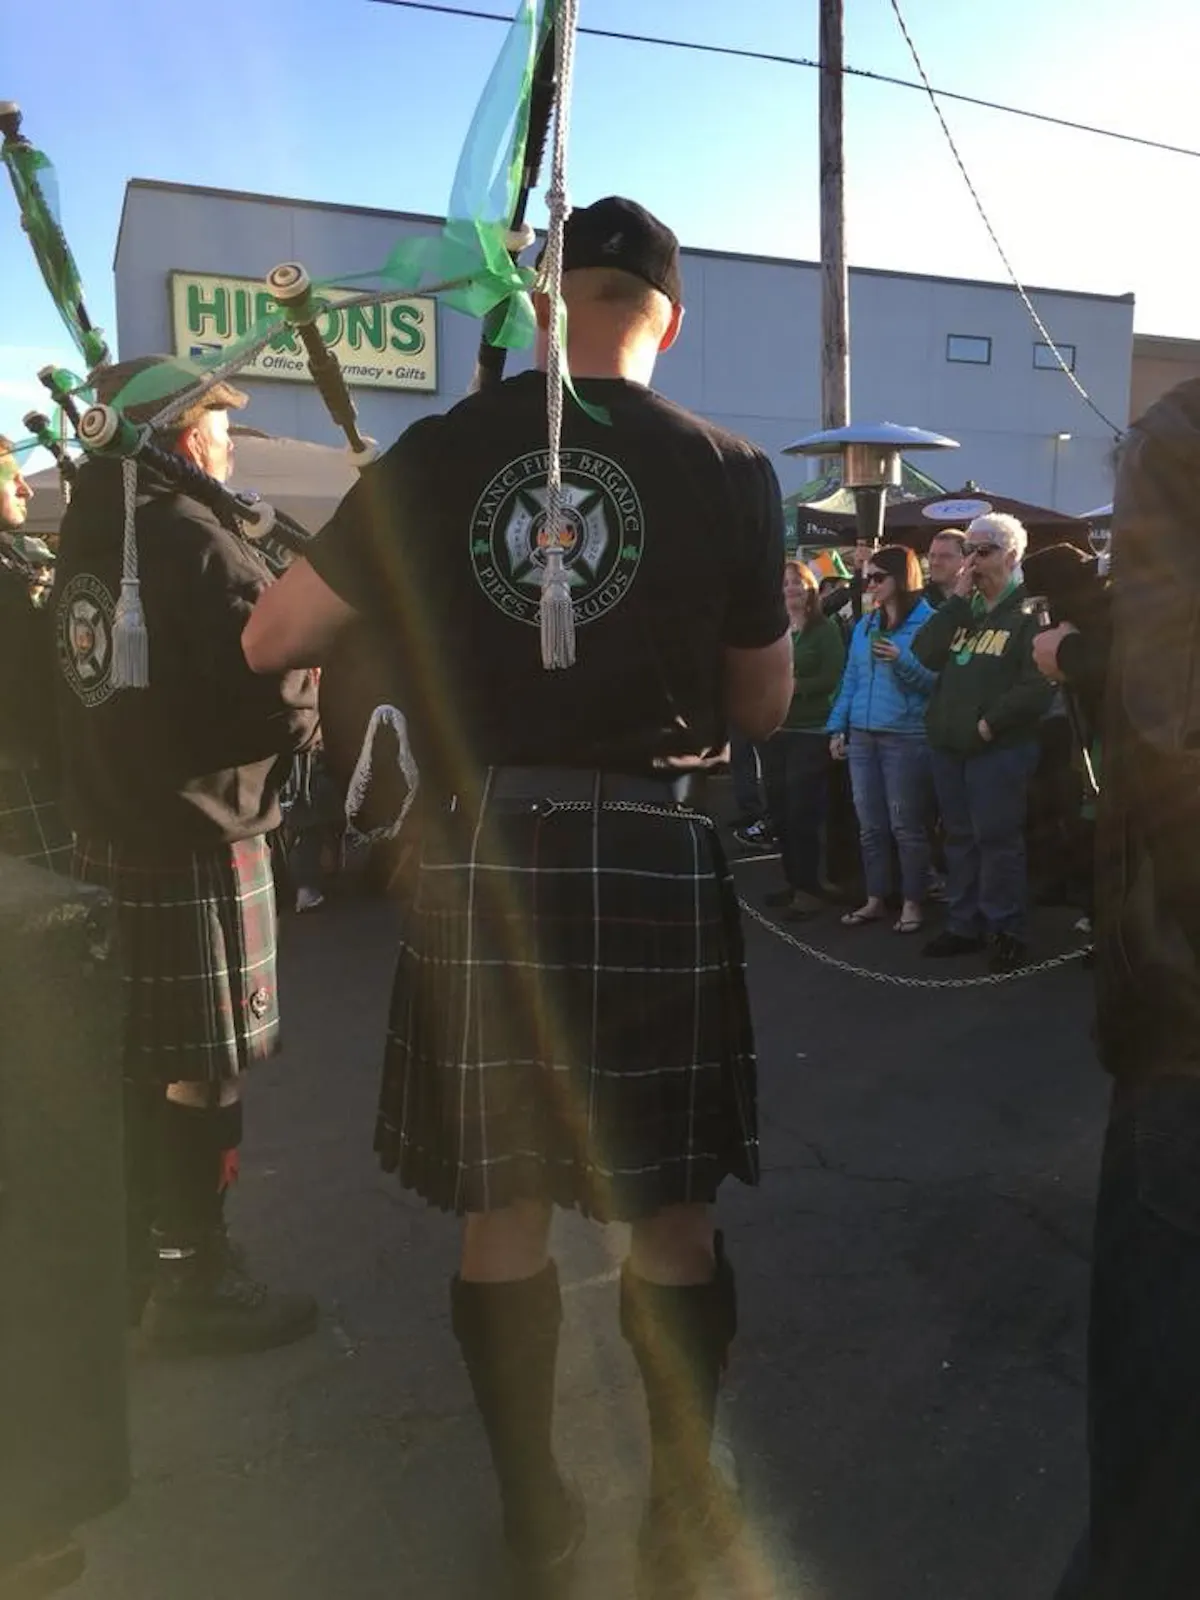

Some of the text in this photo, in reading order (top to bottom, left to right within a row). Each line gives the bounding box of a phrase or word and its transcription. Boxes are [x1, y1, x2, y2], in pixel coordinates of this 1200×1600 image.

[262, 356, 304, 371] Office
[342, 365, 384, 379] rmacy
[395, 367, 426, 380] Gifts
[578, 455, 640, 532] BRIGADE
[480, 566, 528, 616] PIPES
